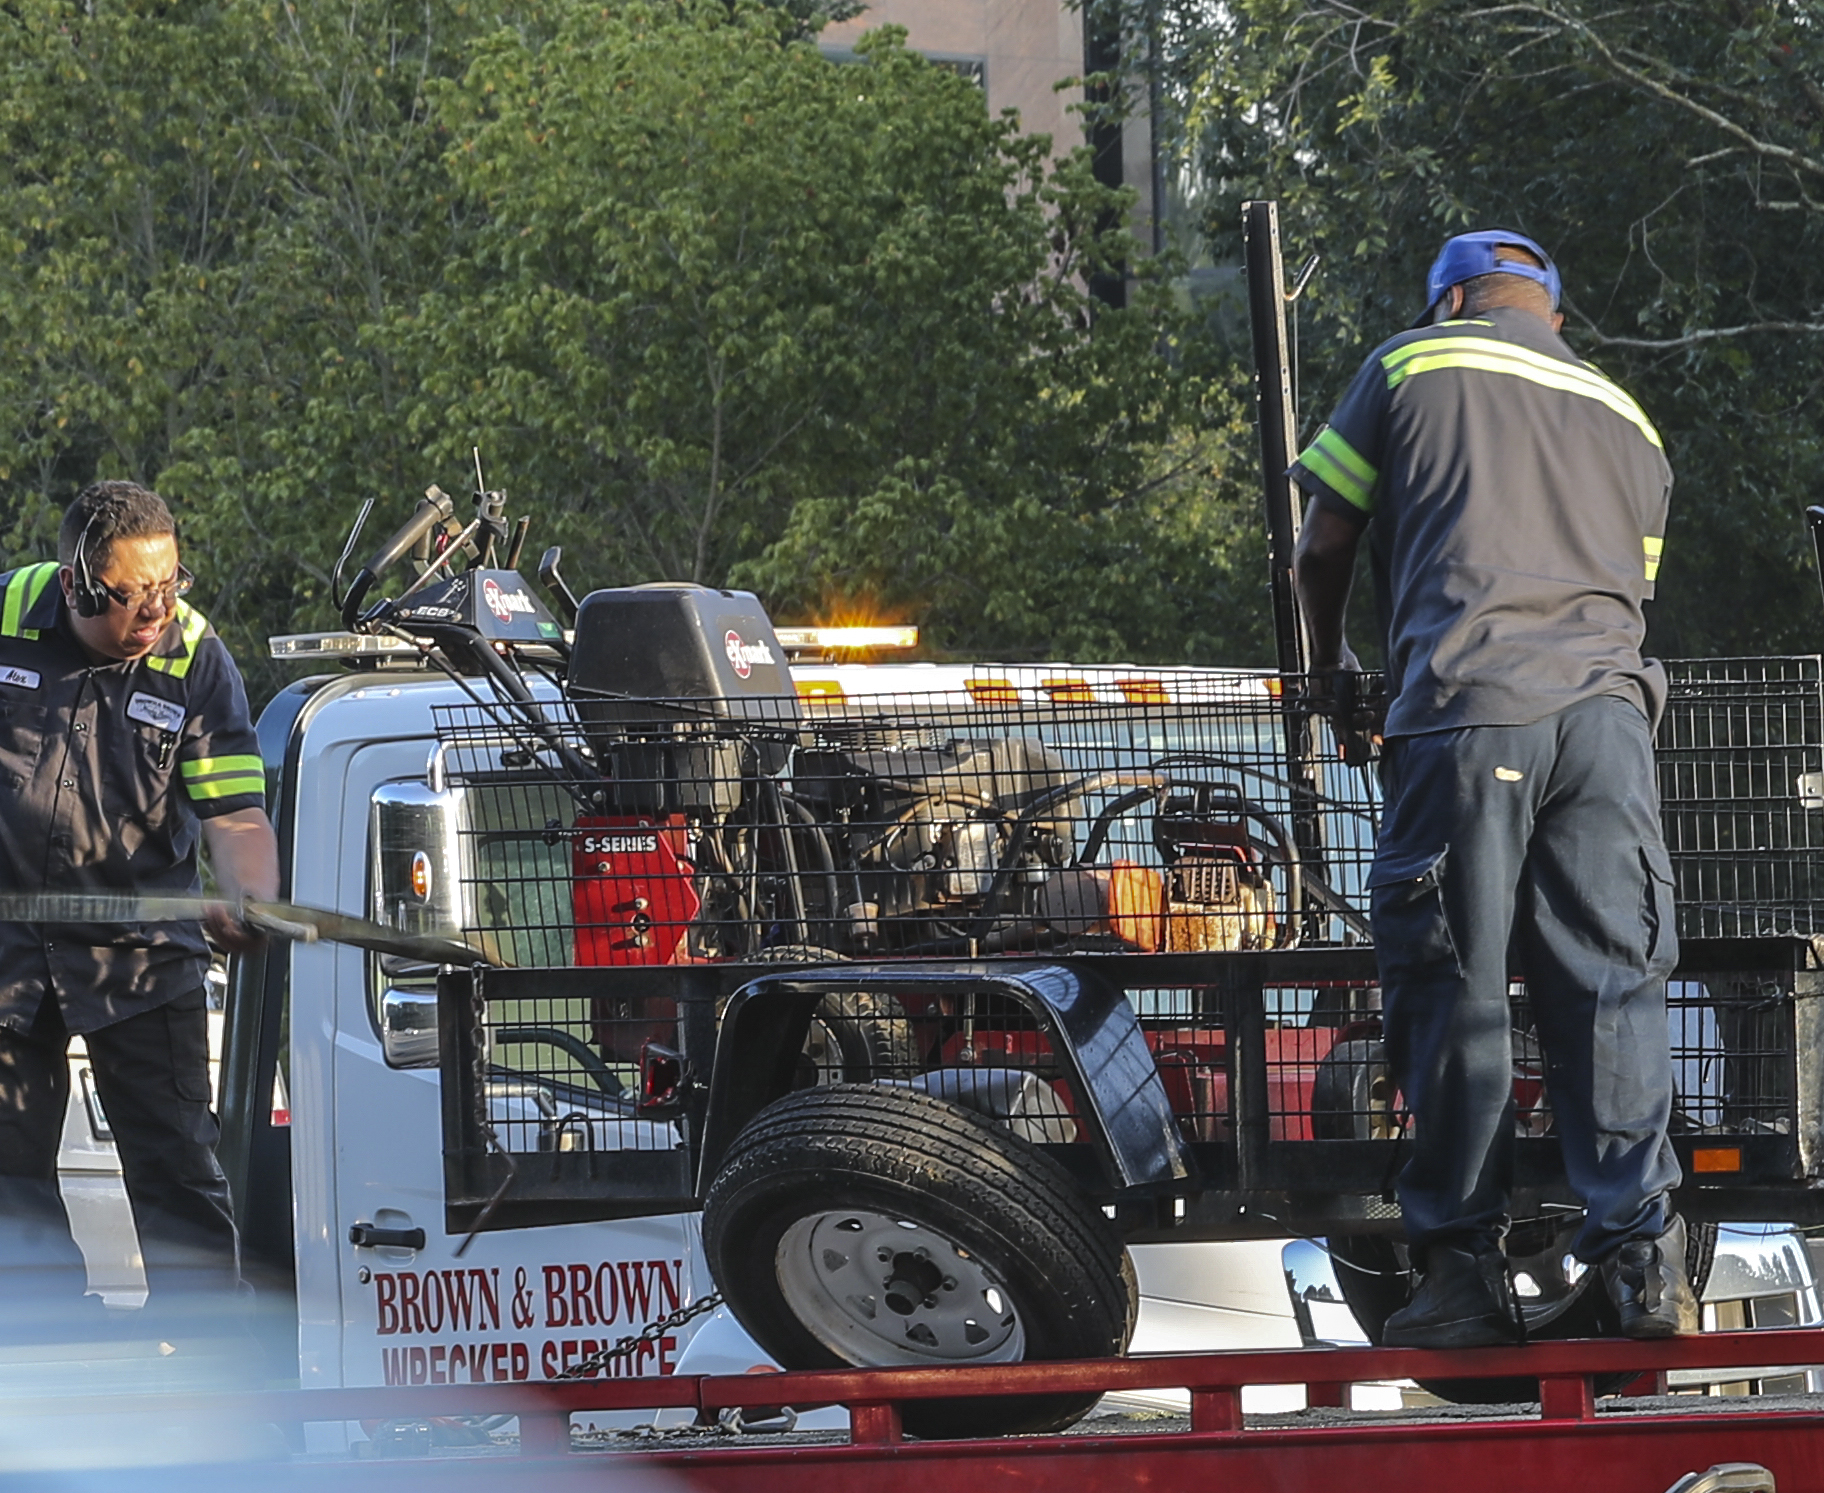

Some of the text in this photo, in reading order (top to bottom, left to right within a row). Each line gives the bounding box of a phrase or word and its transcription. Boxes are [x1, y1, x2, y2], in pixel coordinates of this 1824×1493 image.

[584, 835, 657, 853] S-SERIES
[375, 1259, 683, 1335] BROWN & BROWN
